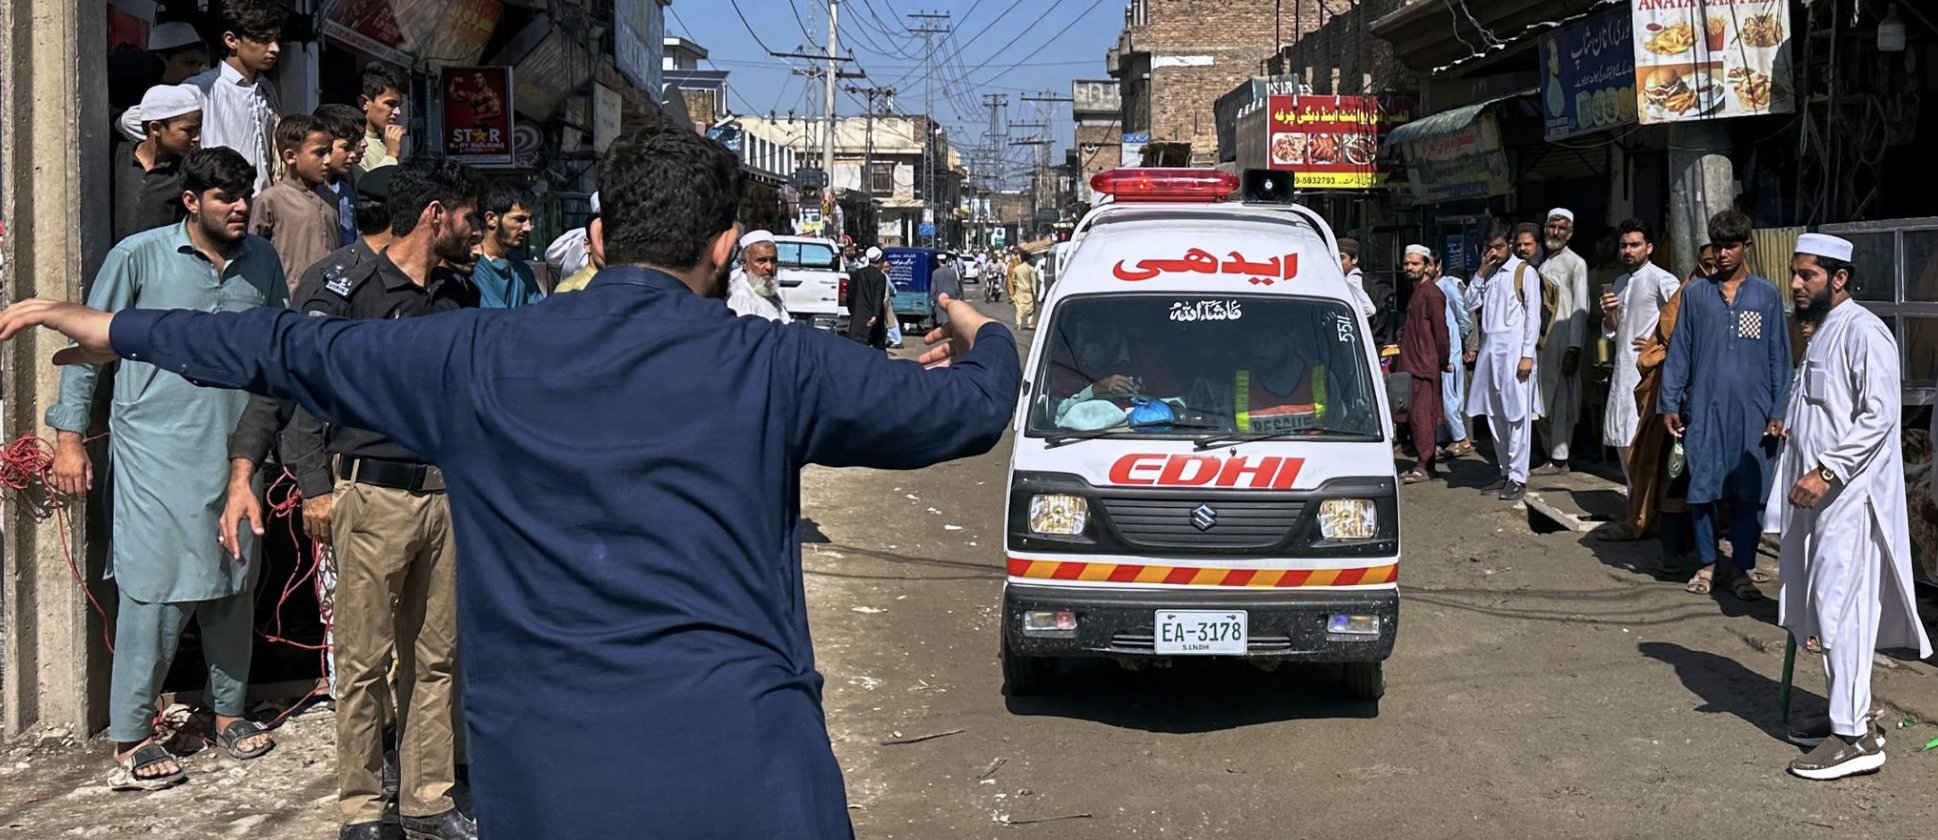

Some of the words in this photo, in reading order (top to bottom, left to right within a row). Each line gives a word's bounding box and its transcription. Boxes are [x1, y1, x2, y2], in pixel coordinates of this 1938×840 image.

[1570, 26, 1592, 70] شاپ
[1297, 105, 1320, 125] دیگی
[1321, 105, 1338, 124] اینڈ
[1294, 176, 1335, 185] 9-5932793
[1112, 247, 1298, 286] ایدھی
[1108, 453, 1305, 489] EDHI
[1162, 621, 1242, 642] EA-3178
